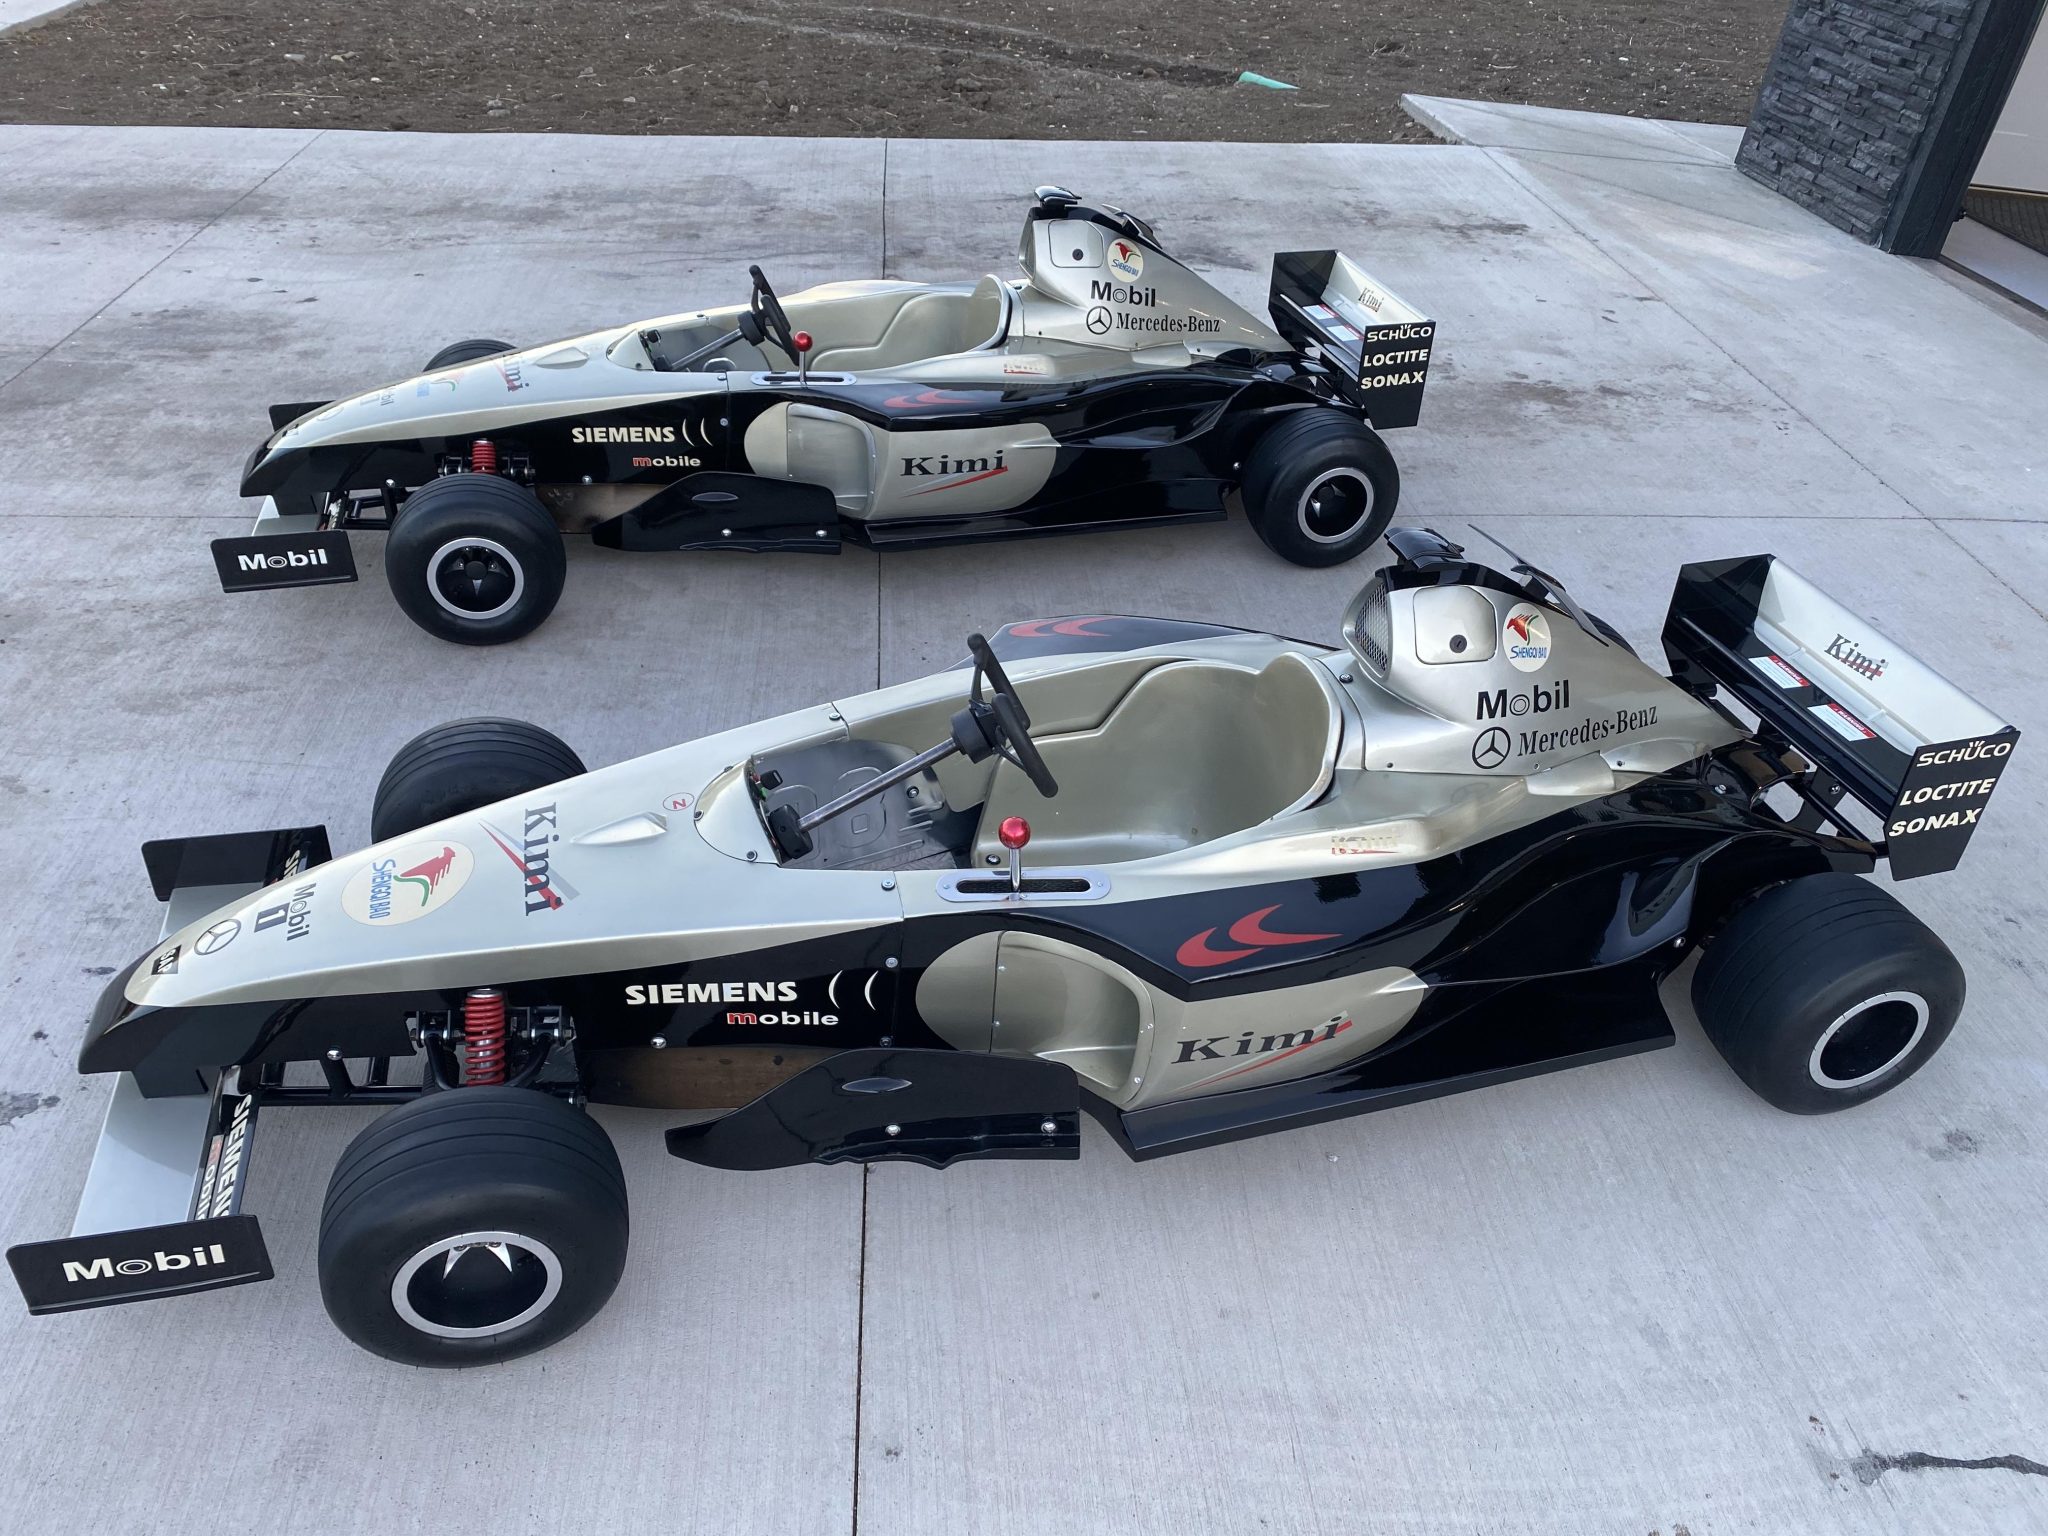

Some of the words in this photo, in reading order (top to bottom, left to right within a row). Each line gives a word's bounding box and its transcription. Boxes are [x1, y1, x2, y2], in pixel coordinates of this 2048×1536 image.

[1090, 279, 1156, 307] Mobil
[1358, 287, 1384, 312] Kimi
[1116, 311, 1220, 333] Mercedes-Benz
[1363, 349, 1429, 368] LOCTITE
[1360, 371, 1425, 390] SONAX
[571, 426, 675, 443] SIEMENS
[632, 456, 701, 467] mobile
[900, 450, 1004, 476] Kimi
[238, 548, 328, 571] Mobil
[1824, 633, 1886, 681] Kimi
[1476, 679, 1570, 720] Mobil
[1517, 705, 1658, 757] Mercedes-Benz
[1900, 778, 1996, 806] LOCTITE
[1888, 807, 1982, 837] SONAX
[524, 802, 563, 916] Kimi
[370, 859, 397, 902] SHENGQI
[287, 883, 317, 941] Mobil
[369, 901, 391, 919] BAO
[625, 981, 798, 1005] SIEMENS
[726, 1011, 839, 1026] mobile
[1171, 1016, 1343, 1064] Kimi
[62, 1243, 226, 1282] Mobil
